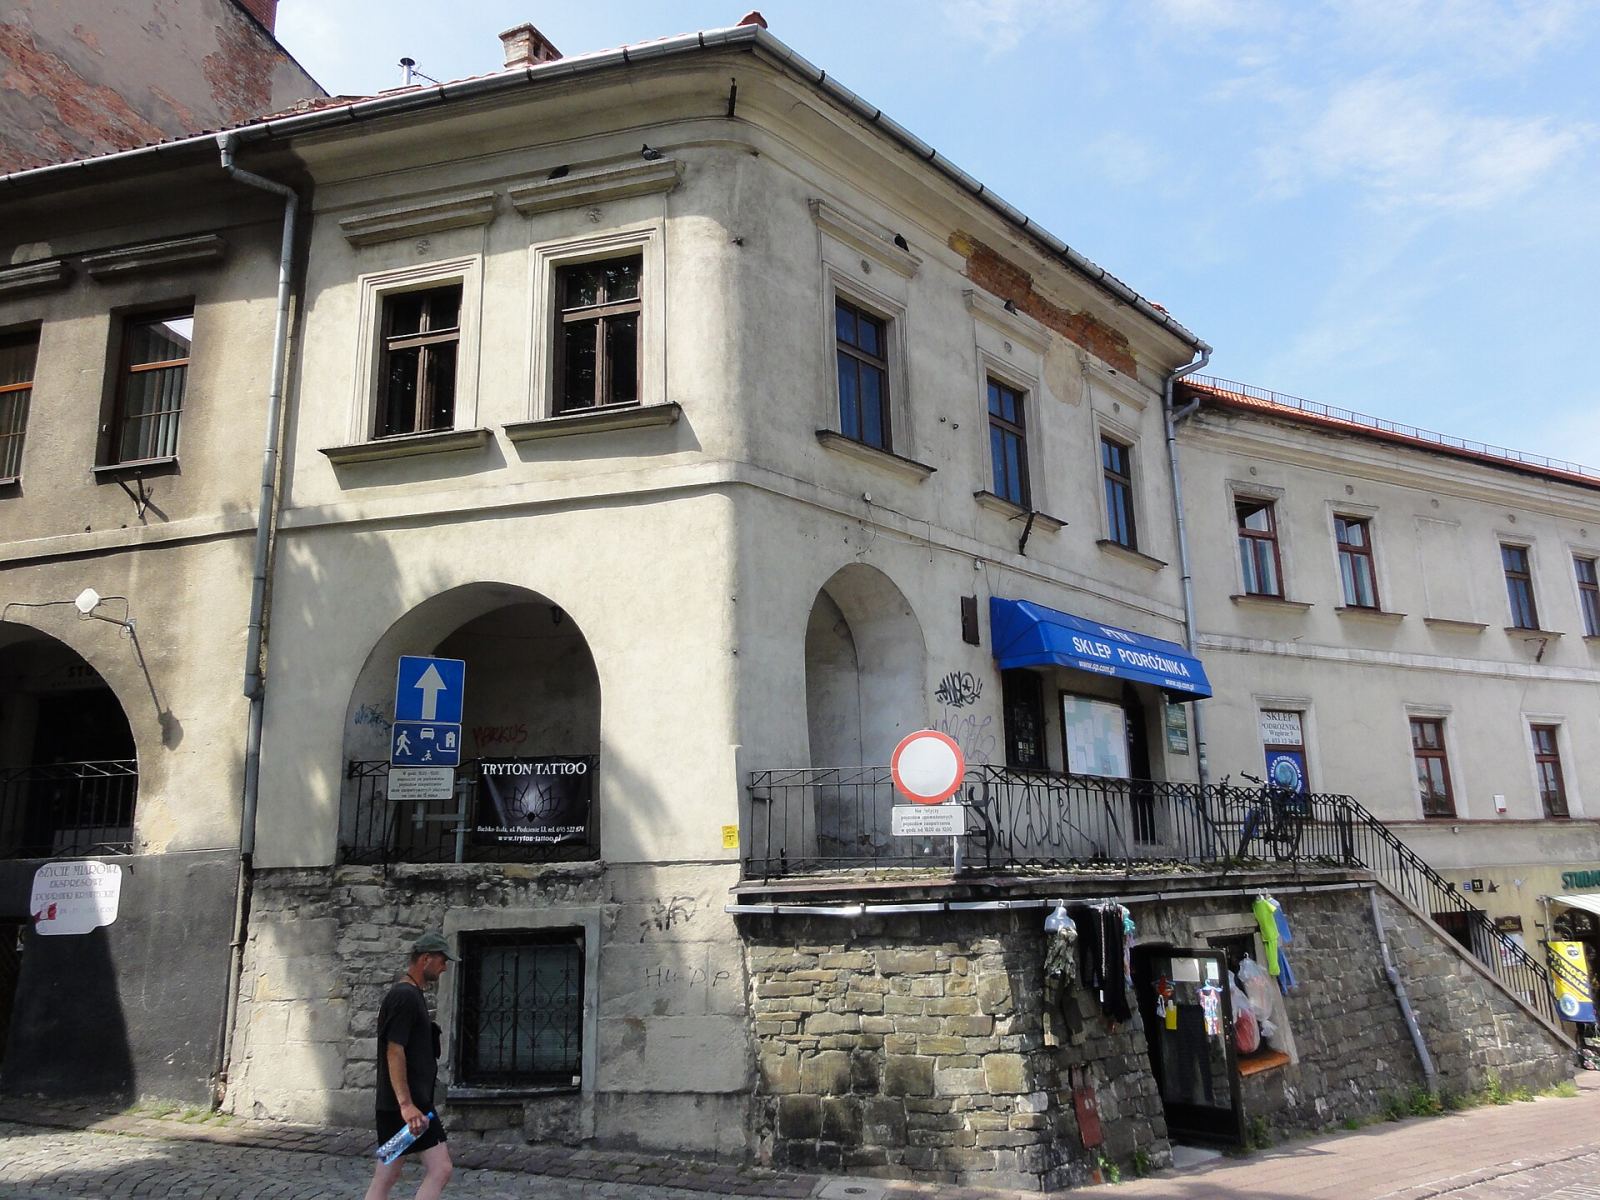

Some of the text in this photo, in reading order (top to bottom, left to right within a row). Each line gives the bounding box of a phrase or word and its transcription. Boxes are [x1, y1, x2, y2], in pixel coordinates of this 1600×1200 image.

[1072, 636, 1191, 678] SKLEP PODRÓŻNIKA
[1266, 712, 1293, 721] SKLEP
[481, 762, 587, 775] TRYTON TATTOO
[38, 866, 70, 878] SZYCIE
